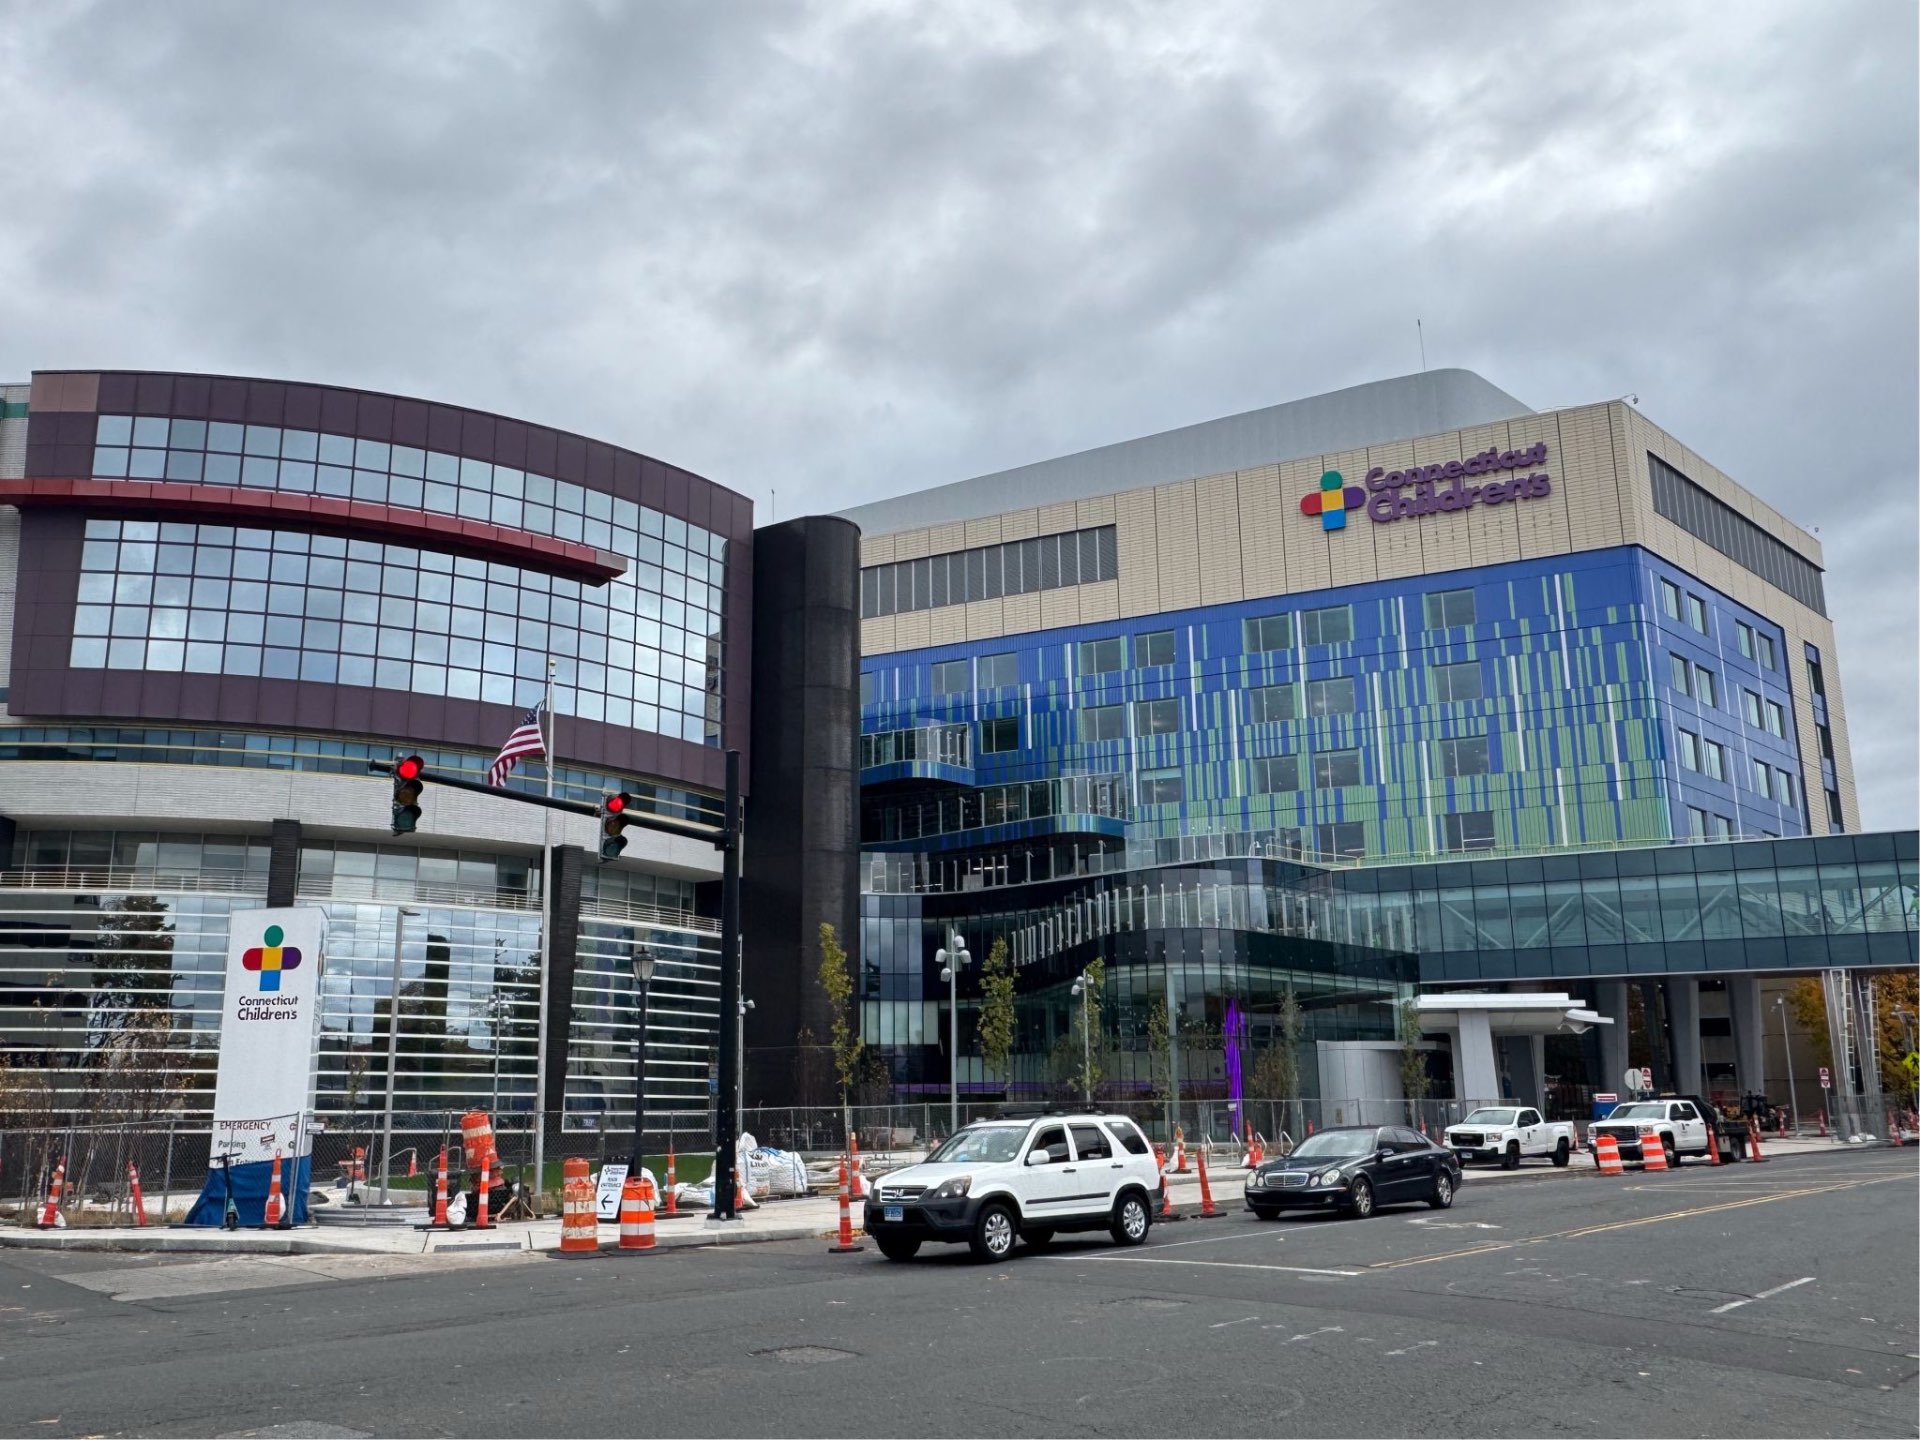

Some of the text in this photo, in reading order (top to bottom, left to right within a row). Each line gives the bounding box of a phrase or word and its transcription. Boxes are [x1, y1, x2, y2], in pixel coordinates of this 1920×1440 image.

[1365, 441, 1547, 491] Connecticut
[1367, 472, 1550, 523] Children's
[239, 995, 298, 1006] Connecticut
[238, 1007, 297, 1020] Children's
[220, 1121, 271, 1130] EMERGENCY
